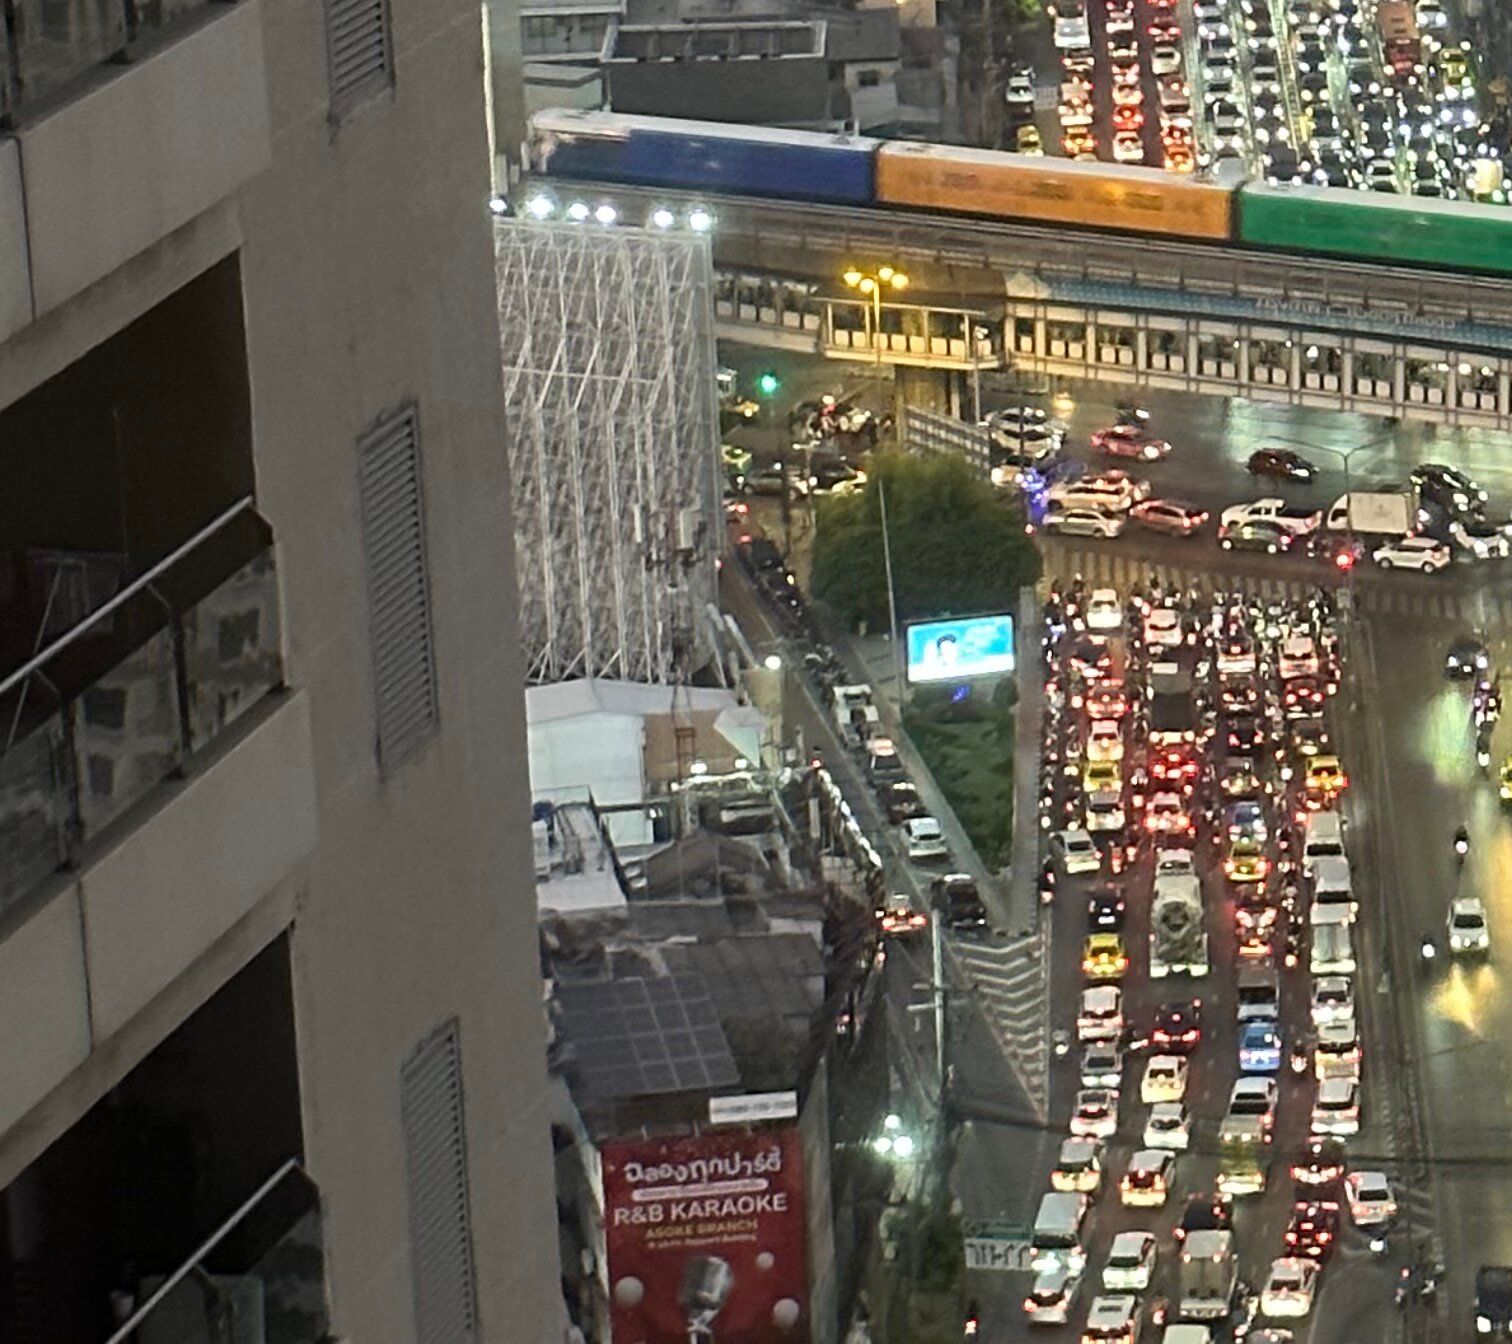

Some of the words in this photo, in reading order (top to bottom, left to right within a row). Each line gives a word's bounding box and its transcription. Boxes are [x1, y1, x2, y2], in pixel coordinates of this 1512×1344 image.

[614, 1204, 664, 1226] R&B
[671, 1192, 788, 1222] KARAOKE
[645, 1224, 694, 1239] ASOKE
[697, 1218, 758, 1235] BRANCH
